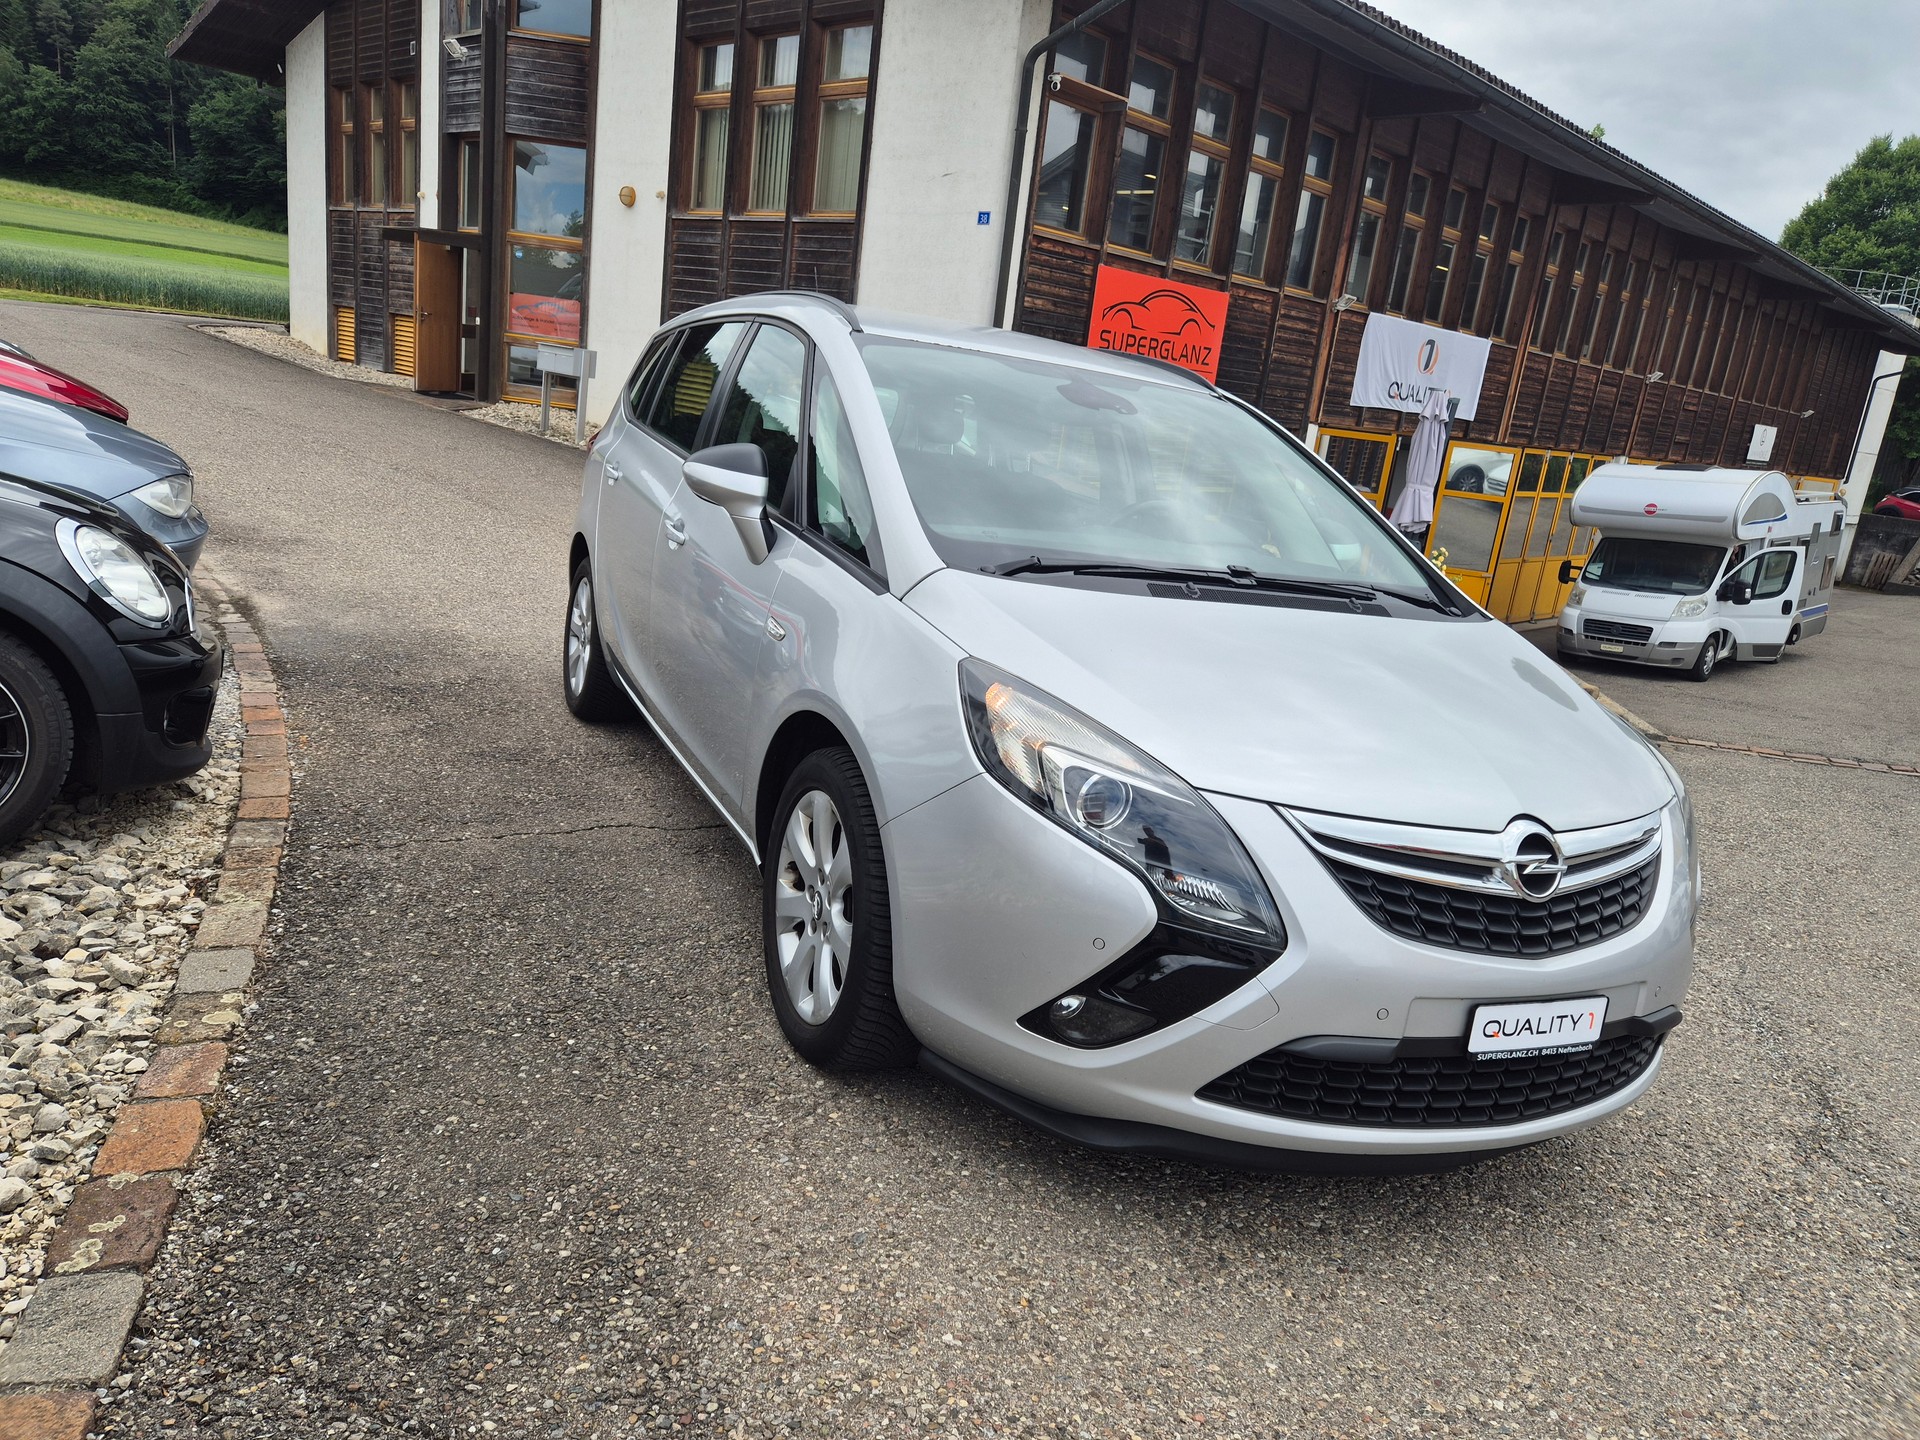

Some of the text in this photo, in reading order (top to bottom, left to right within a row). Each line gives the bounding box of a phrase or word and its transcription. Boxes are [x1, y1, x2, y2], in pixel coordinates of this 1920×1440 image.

[980, 214, 988, 224] 38
[1099, 329, 1212, 366] SUPERGLANZ
[1388, 381, 1447, 404] QUALIT
[1483, 1011, 1595, 1038] QUALITY 1
[1477, 1043, 1593, 1061] SUPERGLANZ.CH 8413 Neftenbach
